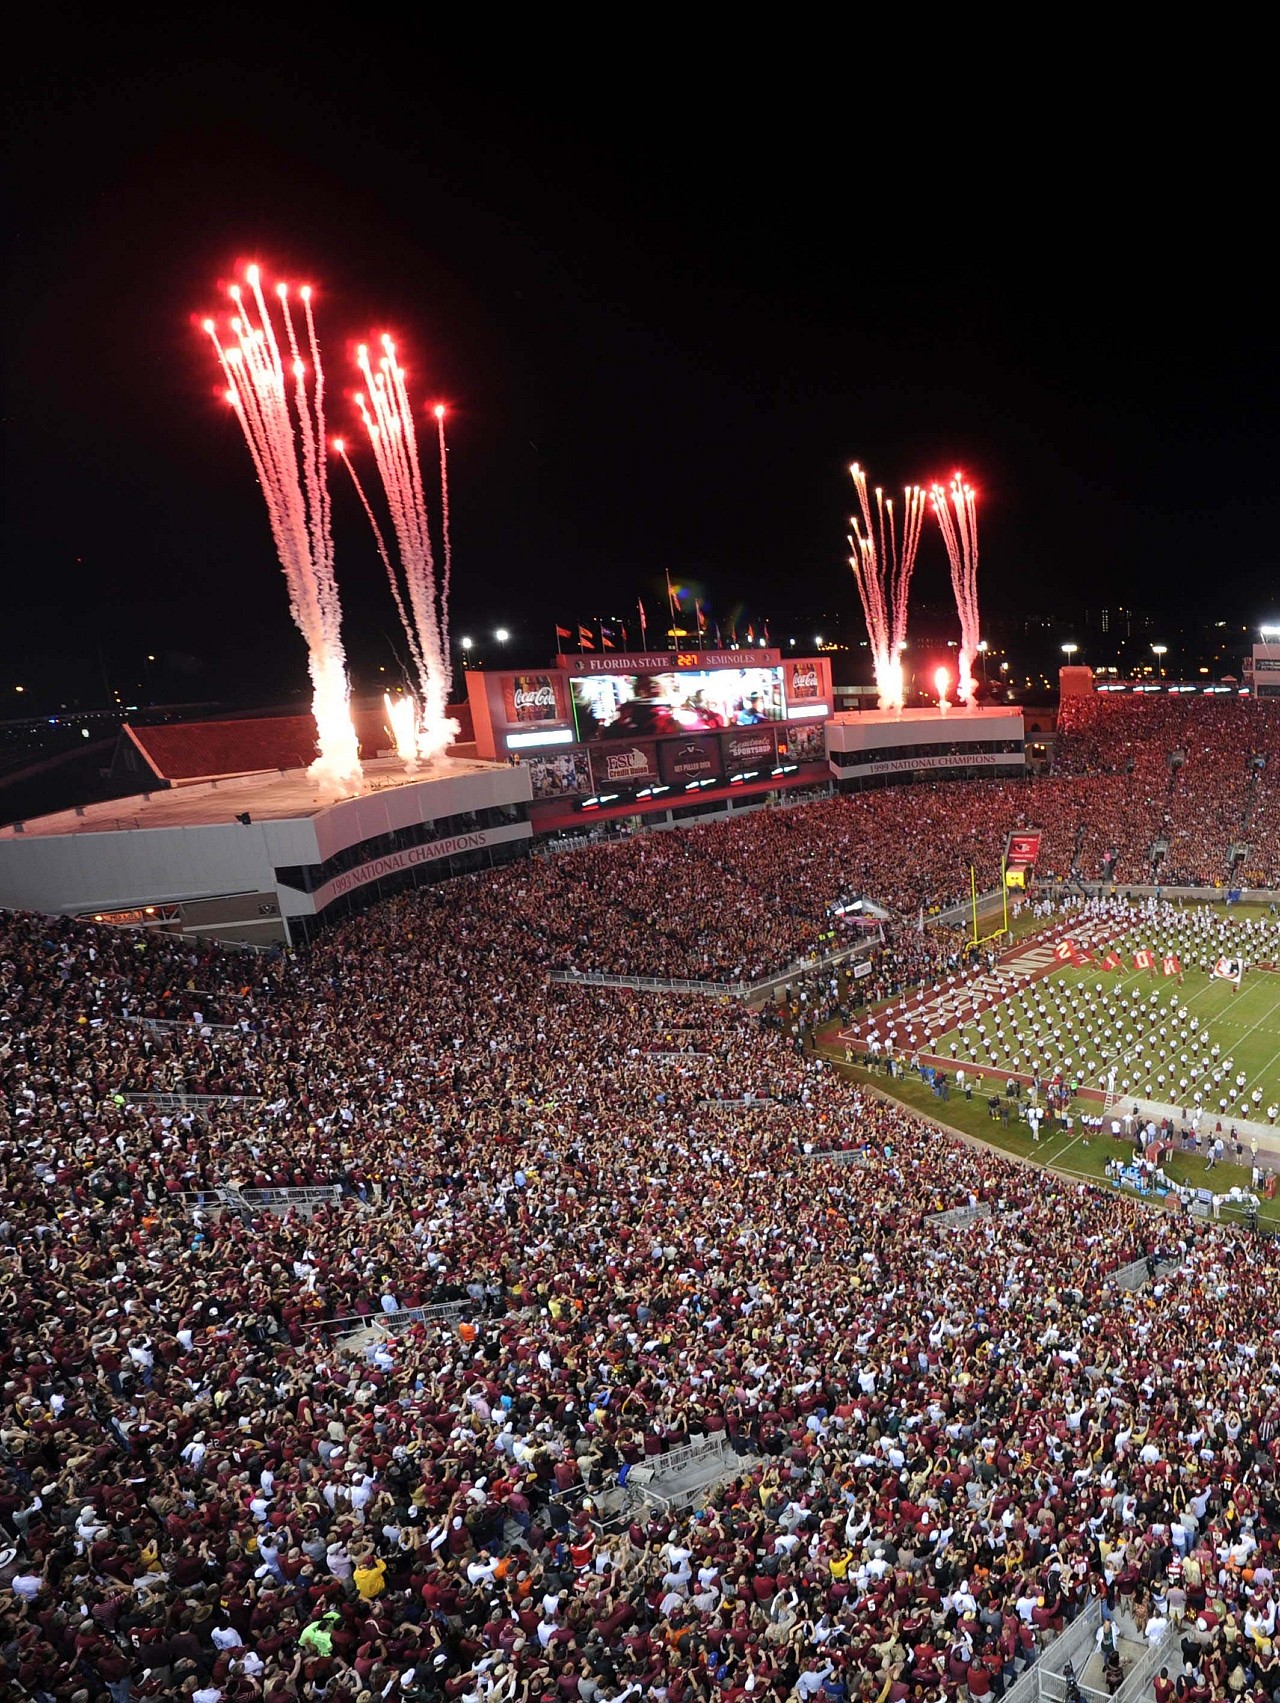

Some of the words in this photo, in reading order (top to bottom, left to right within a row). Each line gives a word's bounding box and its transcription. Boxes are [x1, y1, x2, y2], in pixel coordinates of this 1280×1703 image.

[590, 658, 637, 670] FLORIDA
[638, 656, 669, 668] STATE
[706, 652, 755, 665] SEMINOLES
[607, 754, 636, 770] FSU
[870, 763, 890, 774] 1999
[890, 759, 936, 771] NATIONAL
[938, 755, 996, 768] CHAMPIONS
[332, 874, 351, 895] 1993
[351, 855, 405, 884] NATIONAL
[408, 833, 486, 863] CHAMPIONS
[867, 1599, 876, 1612] 5
